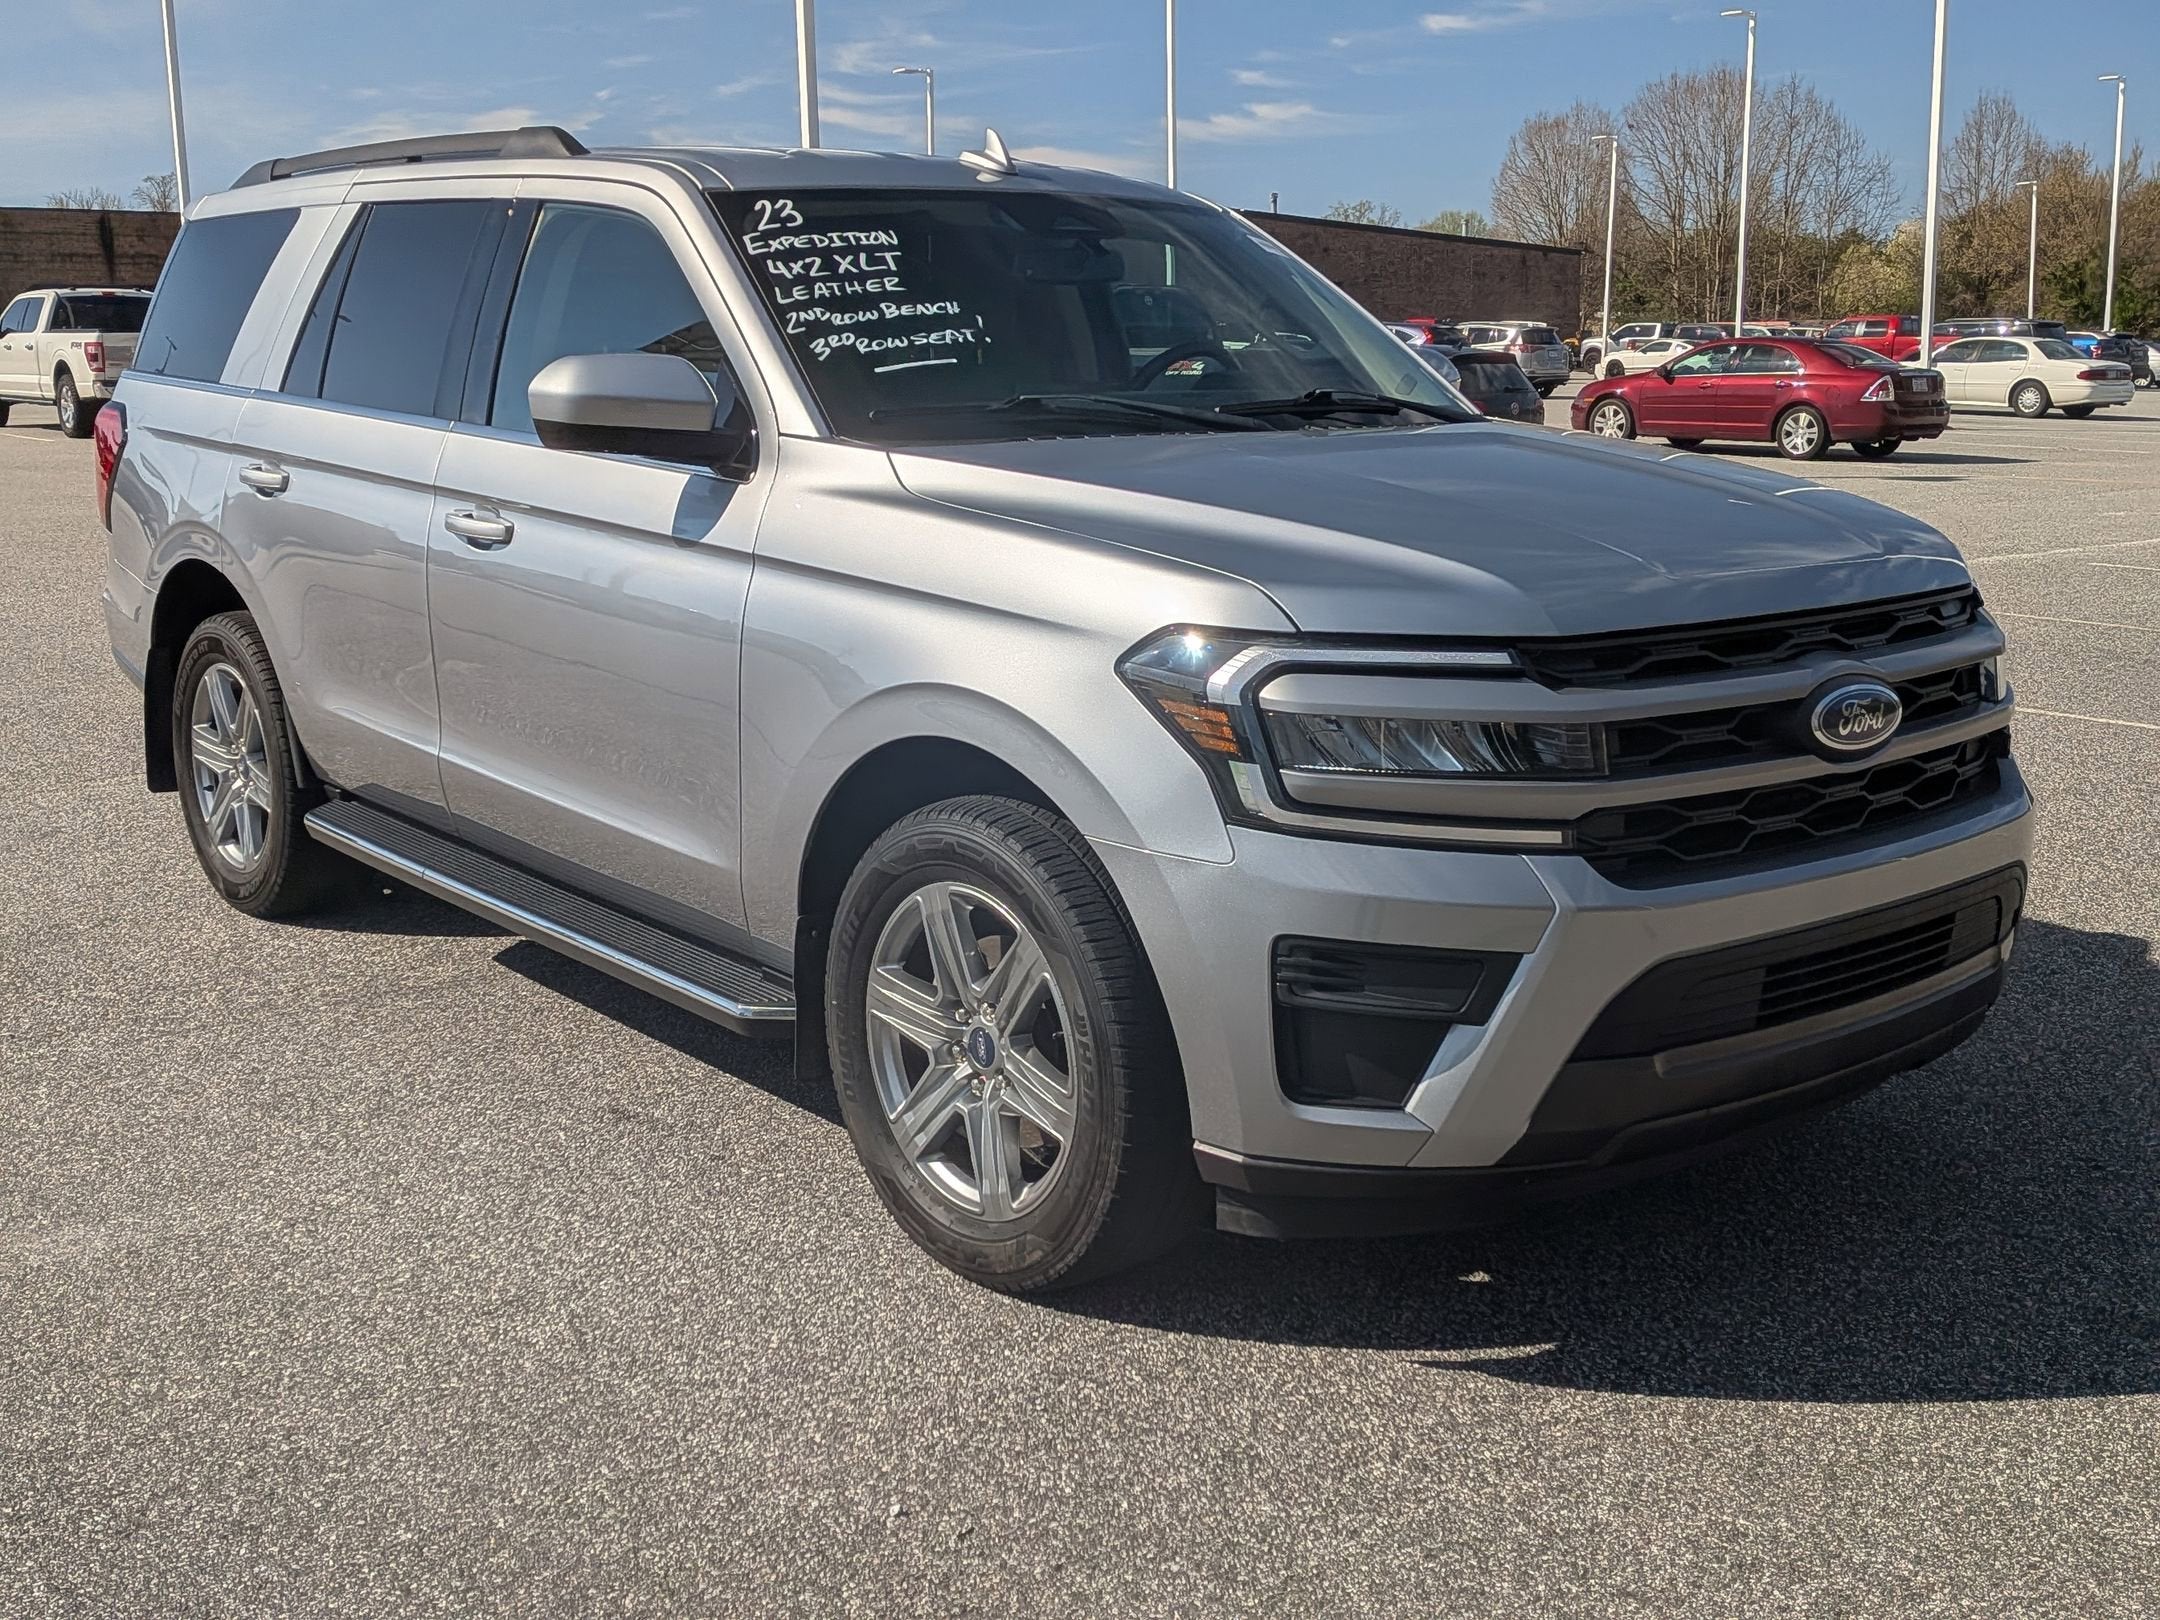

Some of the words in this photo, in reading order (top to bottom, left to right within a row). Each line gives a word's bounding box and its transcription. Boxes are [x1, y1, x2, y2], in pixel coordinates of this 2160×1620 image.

[754, 199, 803, 231] 23
[742, 229, 899, 256] EXPEDITION
[832, 251, 902, 275] XLT
[774, 276, 907, 305] LEATHER
[785, 307, 832, 335] 2ND
[830, 309, 880, 327] ROW
[879, 301, 961, 319] BENCH
[809, 332, 856, 362] 3RD
[855, 336, 910, 355] ROW
[1839, 698, 1885, 736] Ford
